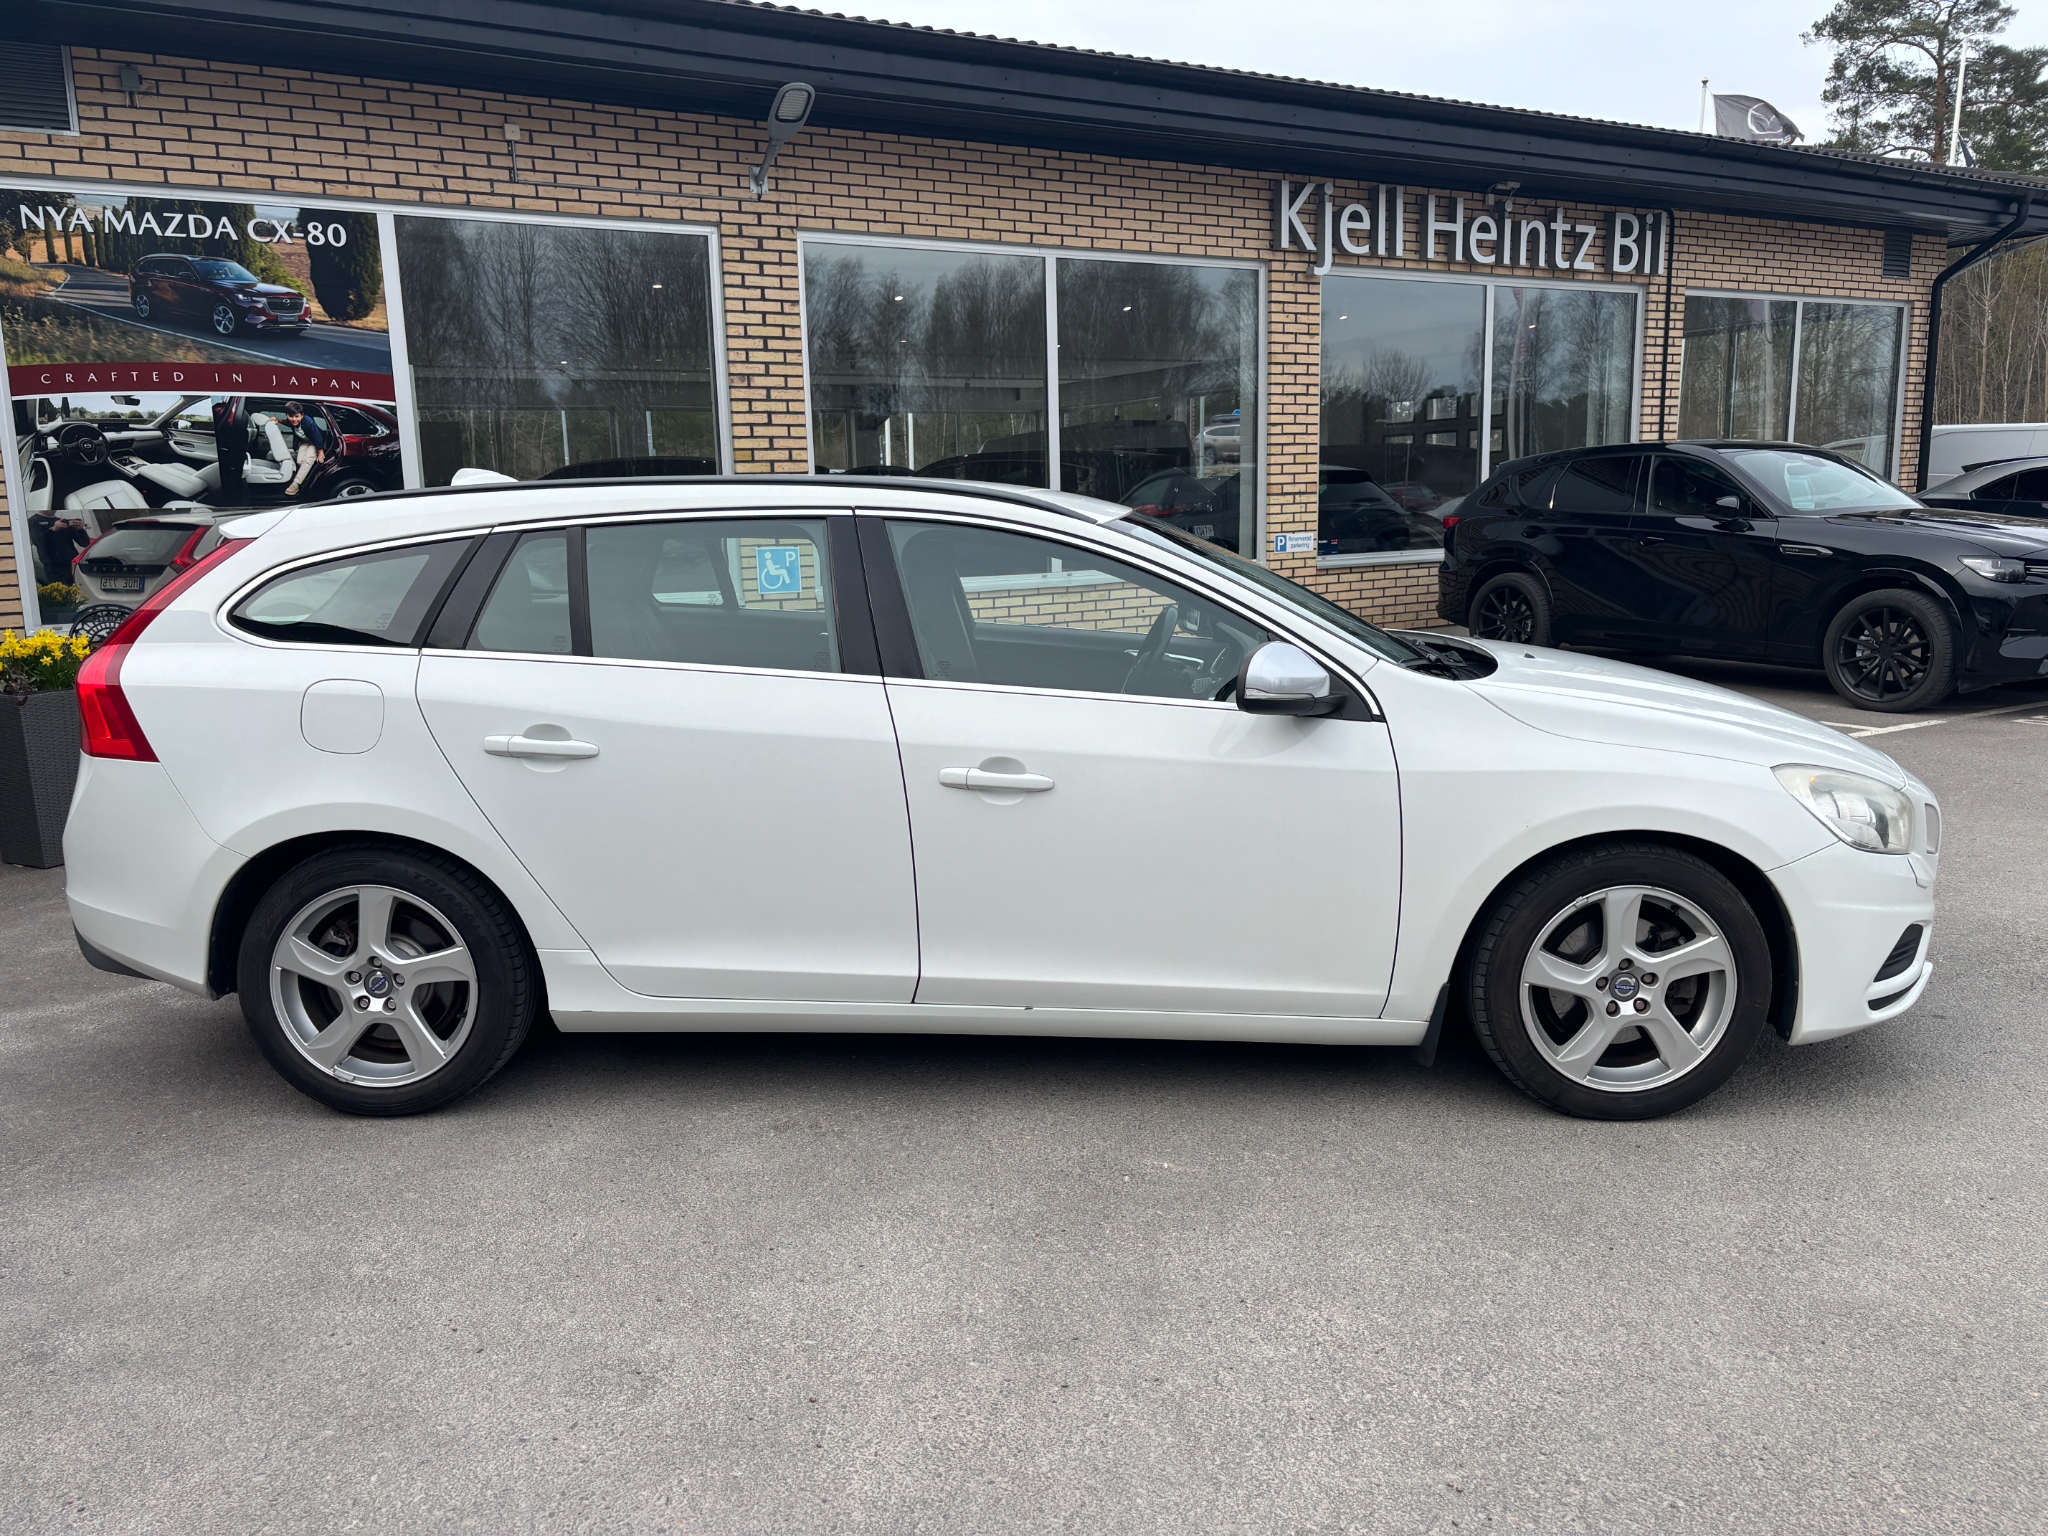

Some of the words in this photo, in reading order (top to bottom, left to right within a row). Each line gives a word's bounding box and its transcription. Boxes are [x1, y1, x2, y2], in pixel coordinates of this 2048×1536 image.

[19, 204, 95, 233] NYA
[104, 209, 239, 241] MAZDA
[247, 218, 347, 248] CX-80
[1279, 180, 1404, 276] Kjell
[1426, 194, 1597, 271] Heintz
[1612, 211, 1667, 275] Bil
[40, 371, 185, 384] CRAFTED
[215, 372, 243, 383] IN
[272, 375, 361, 390] JAPAN
[785, 551, 797, 567] P
[1277, 536, 1286, 551] P
[413, 872, 490, 947] TRIANGLE
